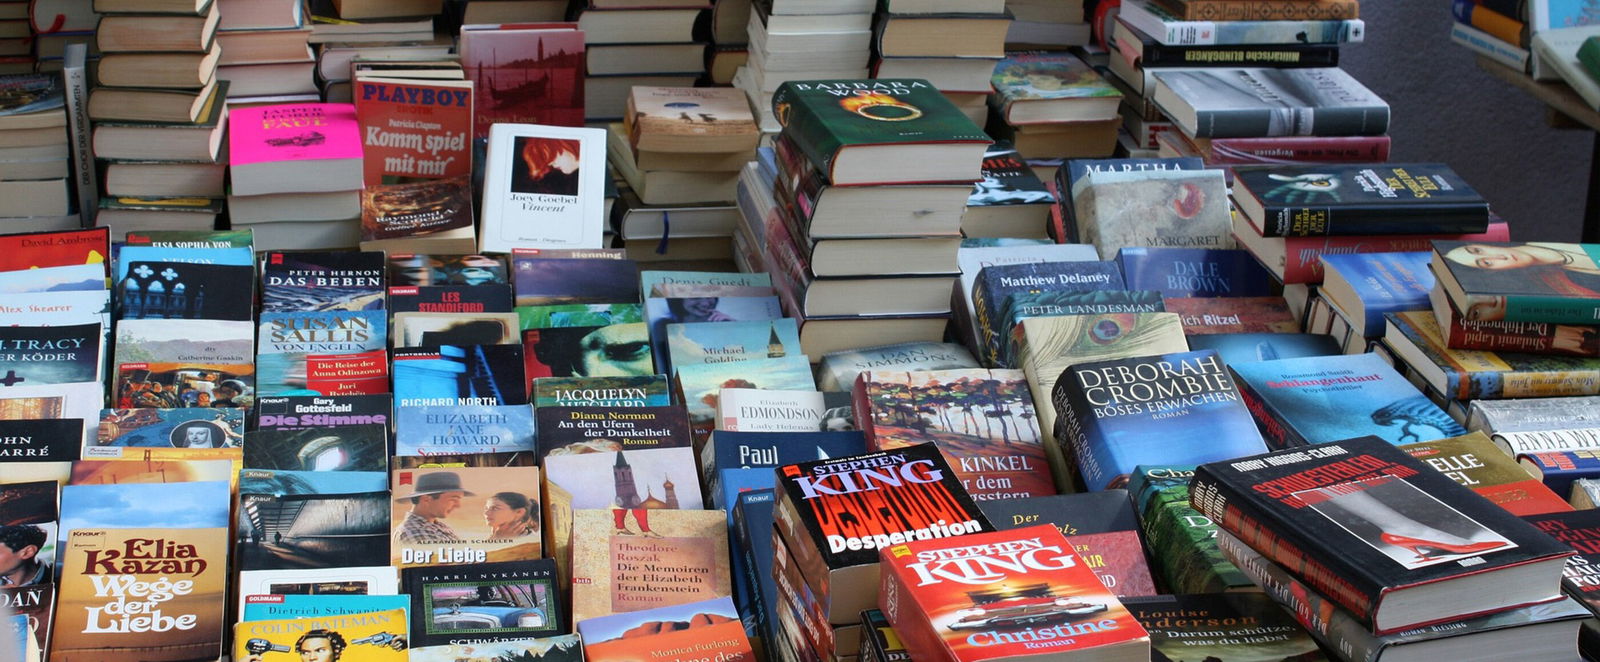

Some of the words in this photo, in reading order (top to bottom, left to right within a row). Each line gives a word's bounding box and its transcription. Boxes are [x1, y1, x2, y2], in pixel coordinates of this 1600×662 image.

[1186, 51, 1245, 62] BLINDGÄNGER
[794, 80, 928, 92] BARBARA
[826, 86, 911, 97] WOOD
[362, 84, 469, 107] PLAYBOY
[366, 126, 425, 154] Komm
[425, 132, 466, 157] spiel
[384, 154, 415, 174] mit
[416, 156, 455, 176] mir
[1086, 162, 1183, 173] MARTHA
[538, 194, 578, 205] Goebel
[522, 202, 566, 213] Vincent
[20, 238, 54, 248] David
[58, 234, 105, 245] Ambrose
[213, 241, 232, 249] VON
[1145, 236, 1221, 247] MARGARET
[571, 251, 622, 260] Henning
[1174, 261, 1219, 277] DALE
[269, 277, 306, 287] DAS
[316, 276, 381, 287] BEBEN
[1000, 276, 1057, 288] Matthew
[1060, 272, 1111, 285] Delaney
[1167, 276, 1231, 293] BROWN
[440, 292, 461, 303] LES
[0, 305, 23, 313] Alex
[29, 304, 73, 313] Shearer
[418, 302, 485, 313] STANDIFORD
[1023, 306, 1063, 315] PETER
[1068, 303, 1156, 314] LANDESMAN
[271, 316, 369, 331] SUSAN
[1204, 314, 1242, 326] Ritzel
[1526, 322, 1548, 336] Der
[270, 330, 369, 344] SALLIS
[1464, 330, 1495, 346] Lapid
[1498, 336, 1546, 350] Shulamit
[10, 338, 86, 351] TRACY
[273, 344, 305, 352] VON
[308, 343, 366, 352] ENGELN
[702, 346, 746, 356] Michael
[20, 351, 78, 362] KÖDER
[178, 354, 215, 362] Catherine
[880, 348, 926, 359] DAN
[318, 362, 334, 370] Die
[360, 360, 376, 368] der
[855, 354, 958, 370] SIMMONS
[337, 368, 382, 377] Odinzowa
[1076, 356, 1223, 389] DEBORAH
[1266, 373, 1384, 389] Schlangenhaut
[556, 388, 648, 402] JACQUELYN
[1086, 374, 1233, 406] CROMBIE
[314, 398, 334, 407] Gary
[400, 398, 455, 407] RICHARD
[458, 397, 497, 406] NORTH
[1094, 404, 1143, 420] BÖSES
[1146, 391, 1238, 414] ERWACHEN
[295, 404, 353, 414] Gottesfeld
[570, 412, 605, 420] Diana
[609, 411, 656, 420] Norman
[740, 406, 825, 421] EDMONDSON
[1152, 409, 1190, 421] ROMAN
[259, 415, 298, 428] Die
[299, 414, 386, 427] Stimme
[426, 414, 508, 425] ELIZABETH
[558, 420, 575, 429] An
[576, 420, 601, 429] den
[602, 420, 635, 429] Ufern
[584, 428, 605, 438] der
[607, 428, 672, 437] Dunkelheit
[432, 435, 501, 446] HOWARD
[622, 438, 659, 446] Roman
[1514, 431, 1570, 451] ANNA
[738, 446, 779, 464] Paul
[812, 454, 907, 476] STEPHEN
[960, 456, 1034, 473] KINKEL
[1230, 458, 1269, 473] MARY
[792, 458, 945, 500] KING
[976, 474, 1013, 490] dem
[748, 494, 770, 502] Knaur
[1192, 481, 1207, 509] MARY
[1012, 513, 1040, 526] Der
[826, 519, 983, 555] Desperation
[122, 538, 198, 560] Elia
[616, 542, 678, 553] Theodore
[916, 538, 1045, 563] STEPHEN
[401, 548, 433, 564] Der
[438, 547, 487, 564] Liebe
[616, 553, 661, 562] Roszak
[81, 550, 208, 578] Kazan
[617, 563, 642, 572] Die
[644, 563, 710, 574] Memoiren
[906, 545, 1077, 589] KING
[422, 574, 469, 582] HARRI
[480, 570, 551, 580] NYKÄNEN
[616, 574, 640, 583] der
[642, 574, 703, 584] Elizabeth
[88, 574, 193, 602] Wege
[617, 584, 701, 593] Frankenstein
[104, 595, 158, 615] der
[618, 594, 665, 603] Roman
[268, 606, 320, 615] Dietrich
[326, 606, 388, 615] Schwanitz
[1138, 610, 1209, 619] Louise
[80, 606, 197, 634] Liebe
[251, 622, 304, 635] COLIN
[312, 614, 391, 631] BATEMAN
[966, 616, 1119, 648] Christine
[1166, 628, 1225, 639] Darum
[1024, 637, 1076, 650] Roman
[1183, 637, 1210, 647] was
[1214, 636, 1238, 646] du
[1242, 632, 1290, 644] liebst
[651, 646, 695, 658] Monica
[696, 638, 741, 653] Furlong
